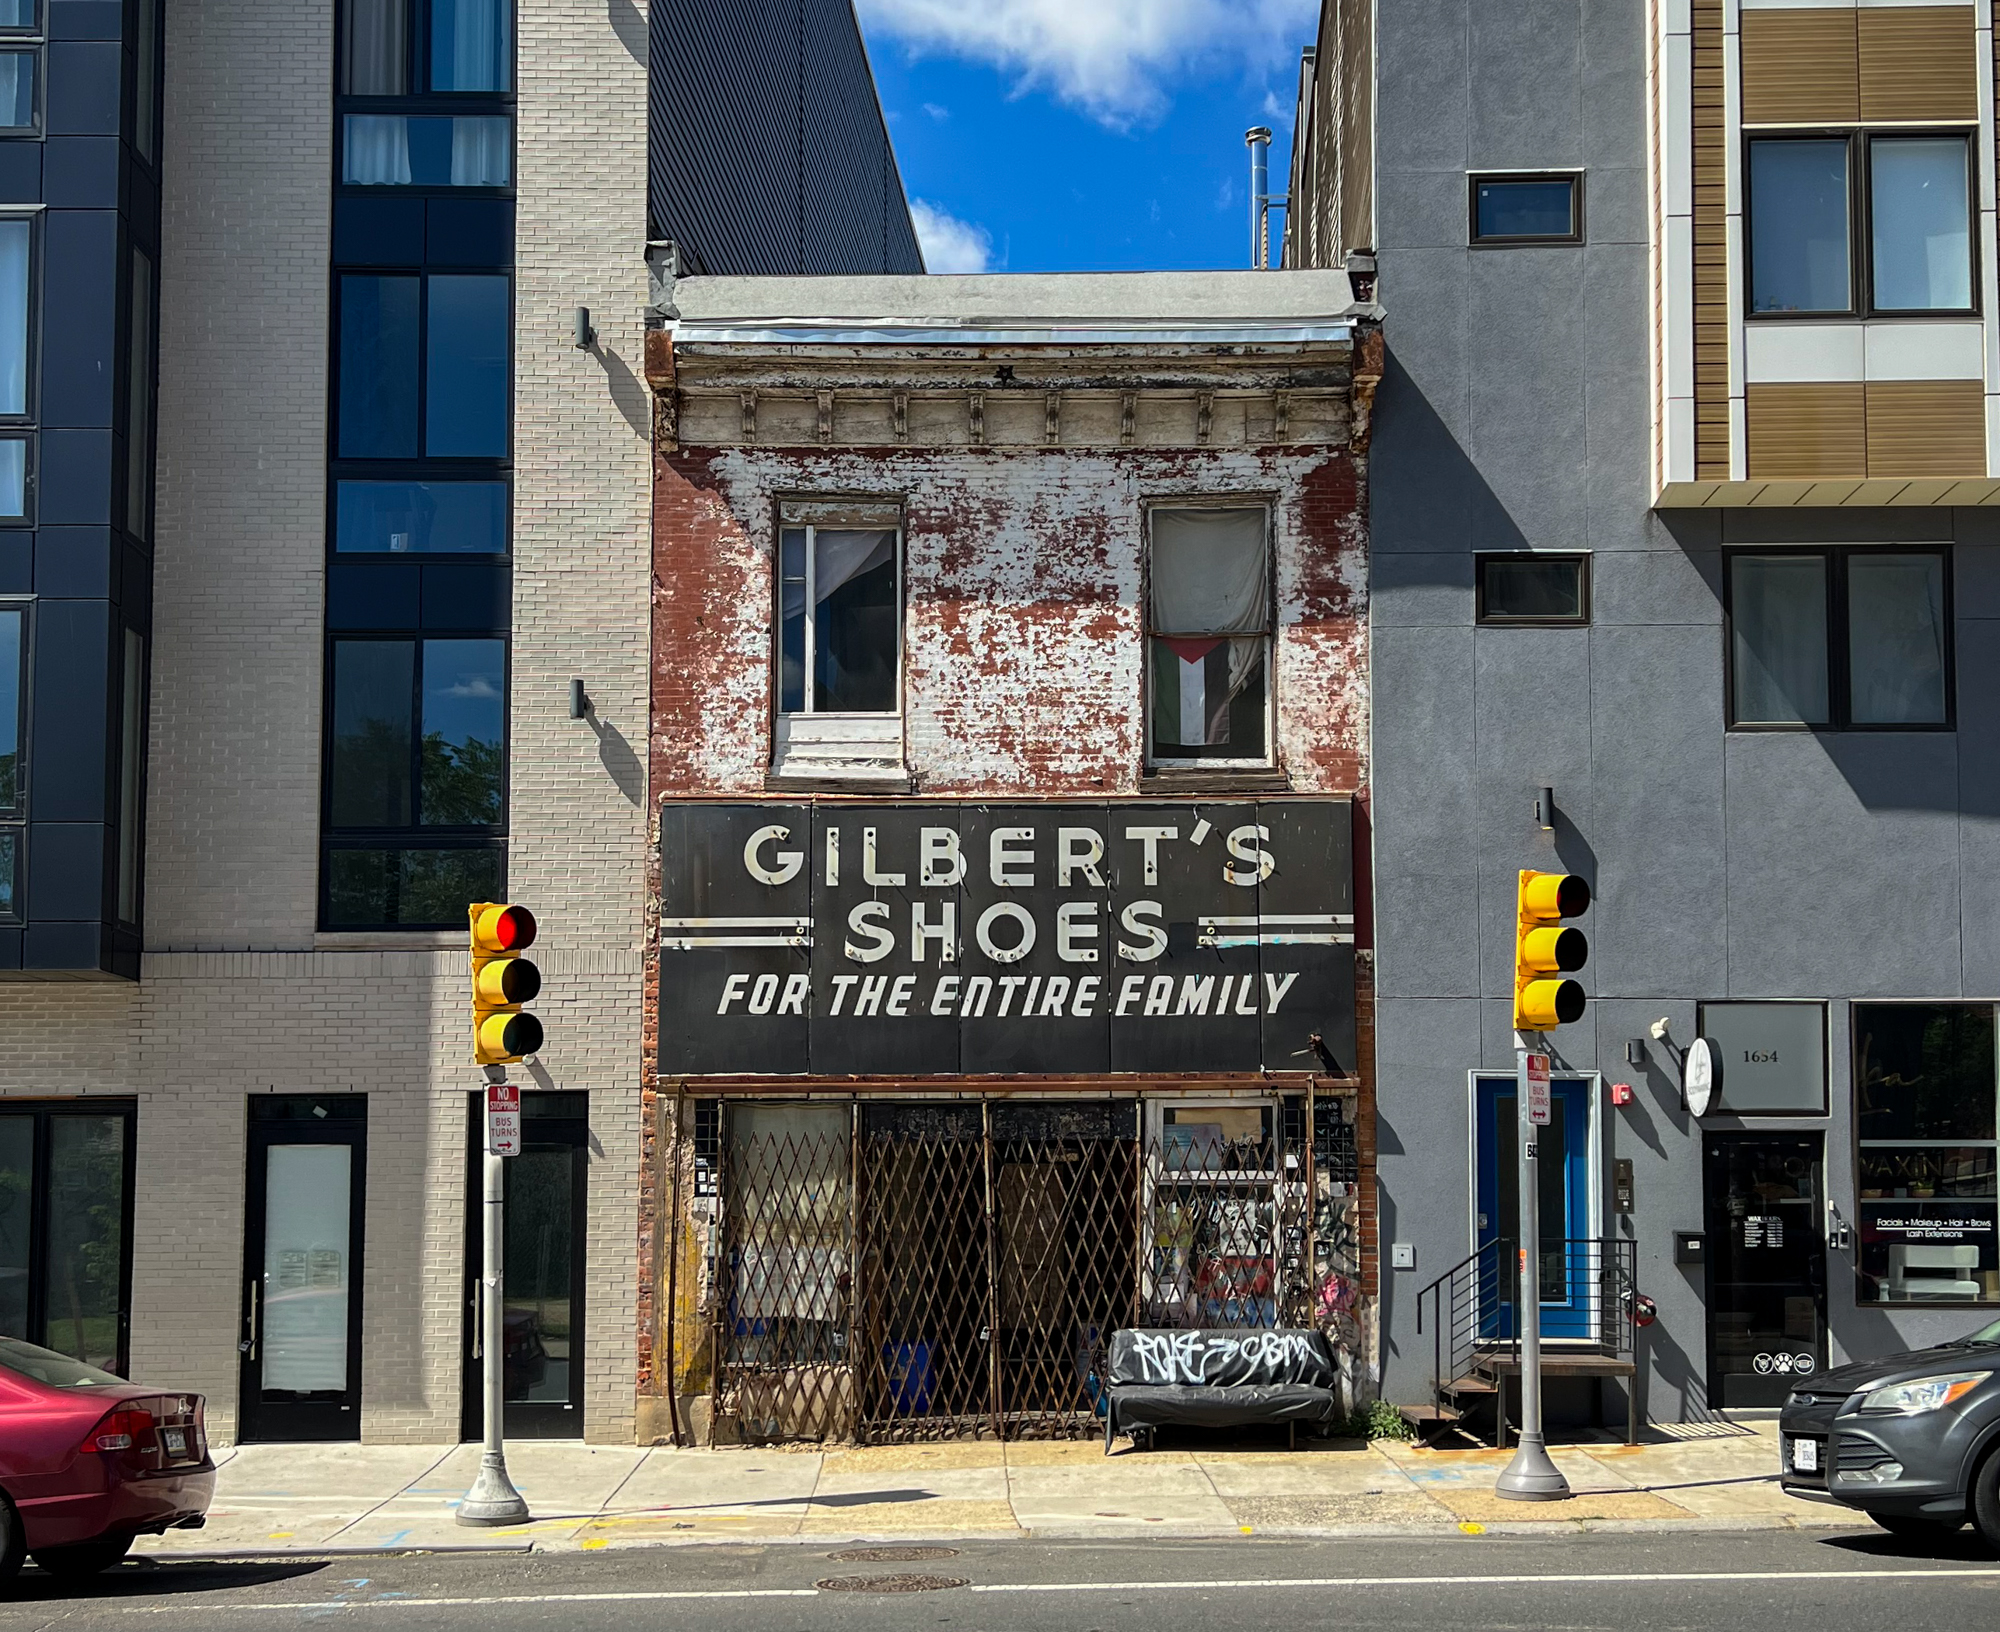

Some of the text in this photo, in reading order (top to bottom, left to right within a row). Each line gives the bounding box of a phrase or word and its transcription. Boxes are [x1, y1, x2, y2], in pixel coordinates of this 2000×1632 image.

[743, 819, 1275, 888] GILBERT'S
[844, 900, 1168, 963] SHOES
[716, 973, 1300, 1017] FOR THE ENTIRE FAMILY
[1743, 1050, 1778, 1063] 1654
[1533, 1056, 1543, 1069] NO
[497, 1087, 510, 1100] NO
[1532, 1086, 1545, 1096] BUS
[489, 1101, 518, 1111] STOPPING
[1529, 1097, 1549, 1107] TURNS
[495, 1117, 512, 1127] BUS
[491, 1128, 518, 1137] TURNS
[1876, 1218, 1992, 1228] Facials Makeup Hair Brows
[1906, 1230, 1963, 1238] Lash Extensions
